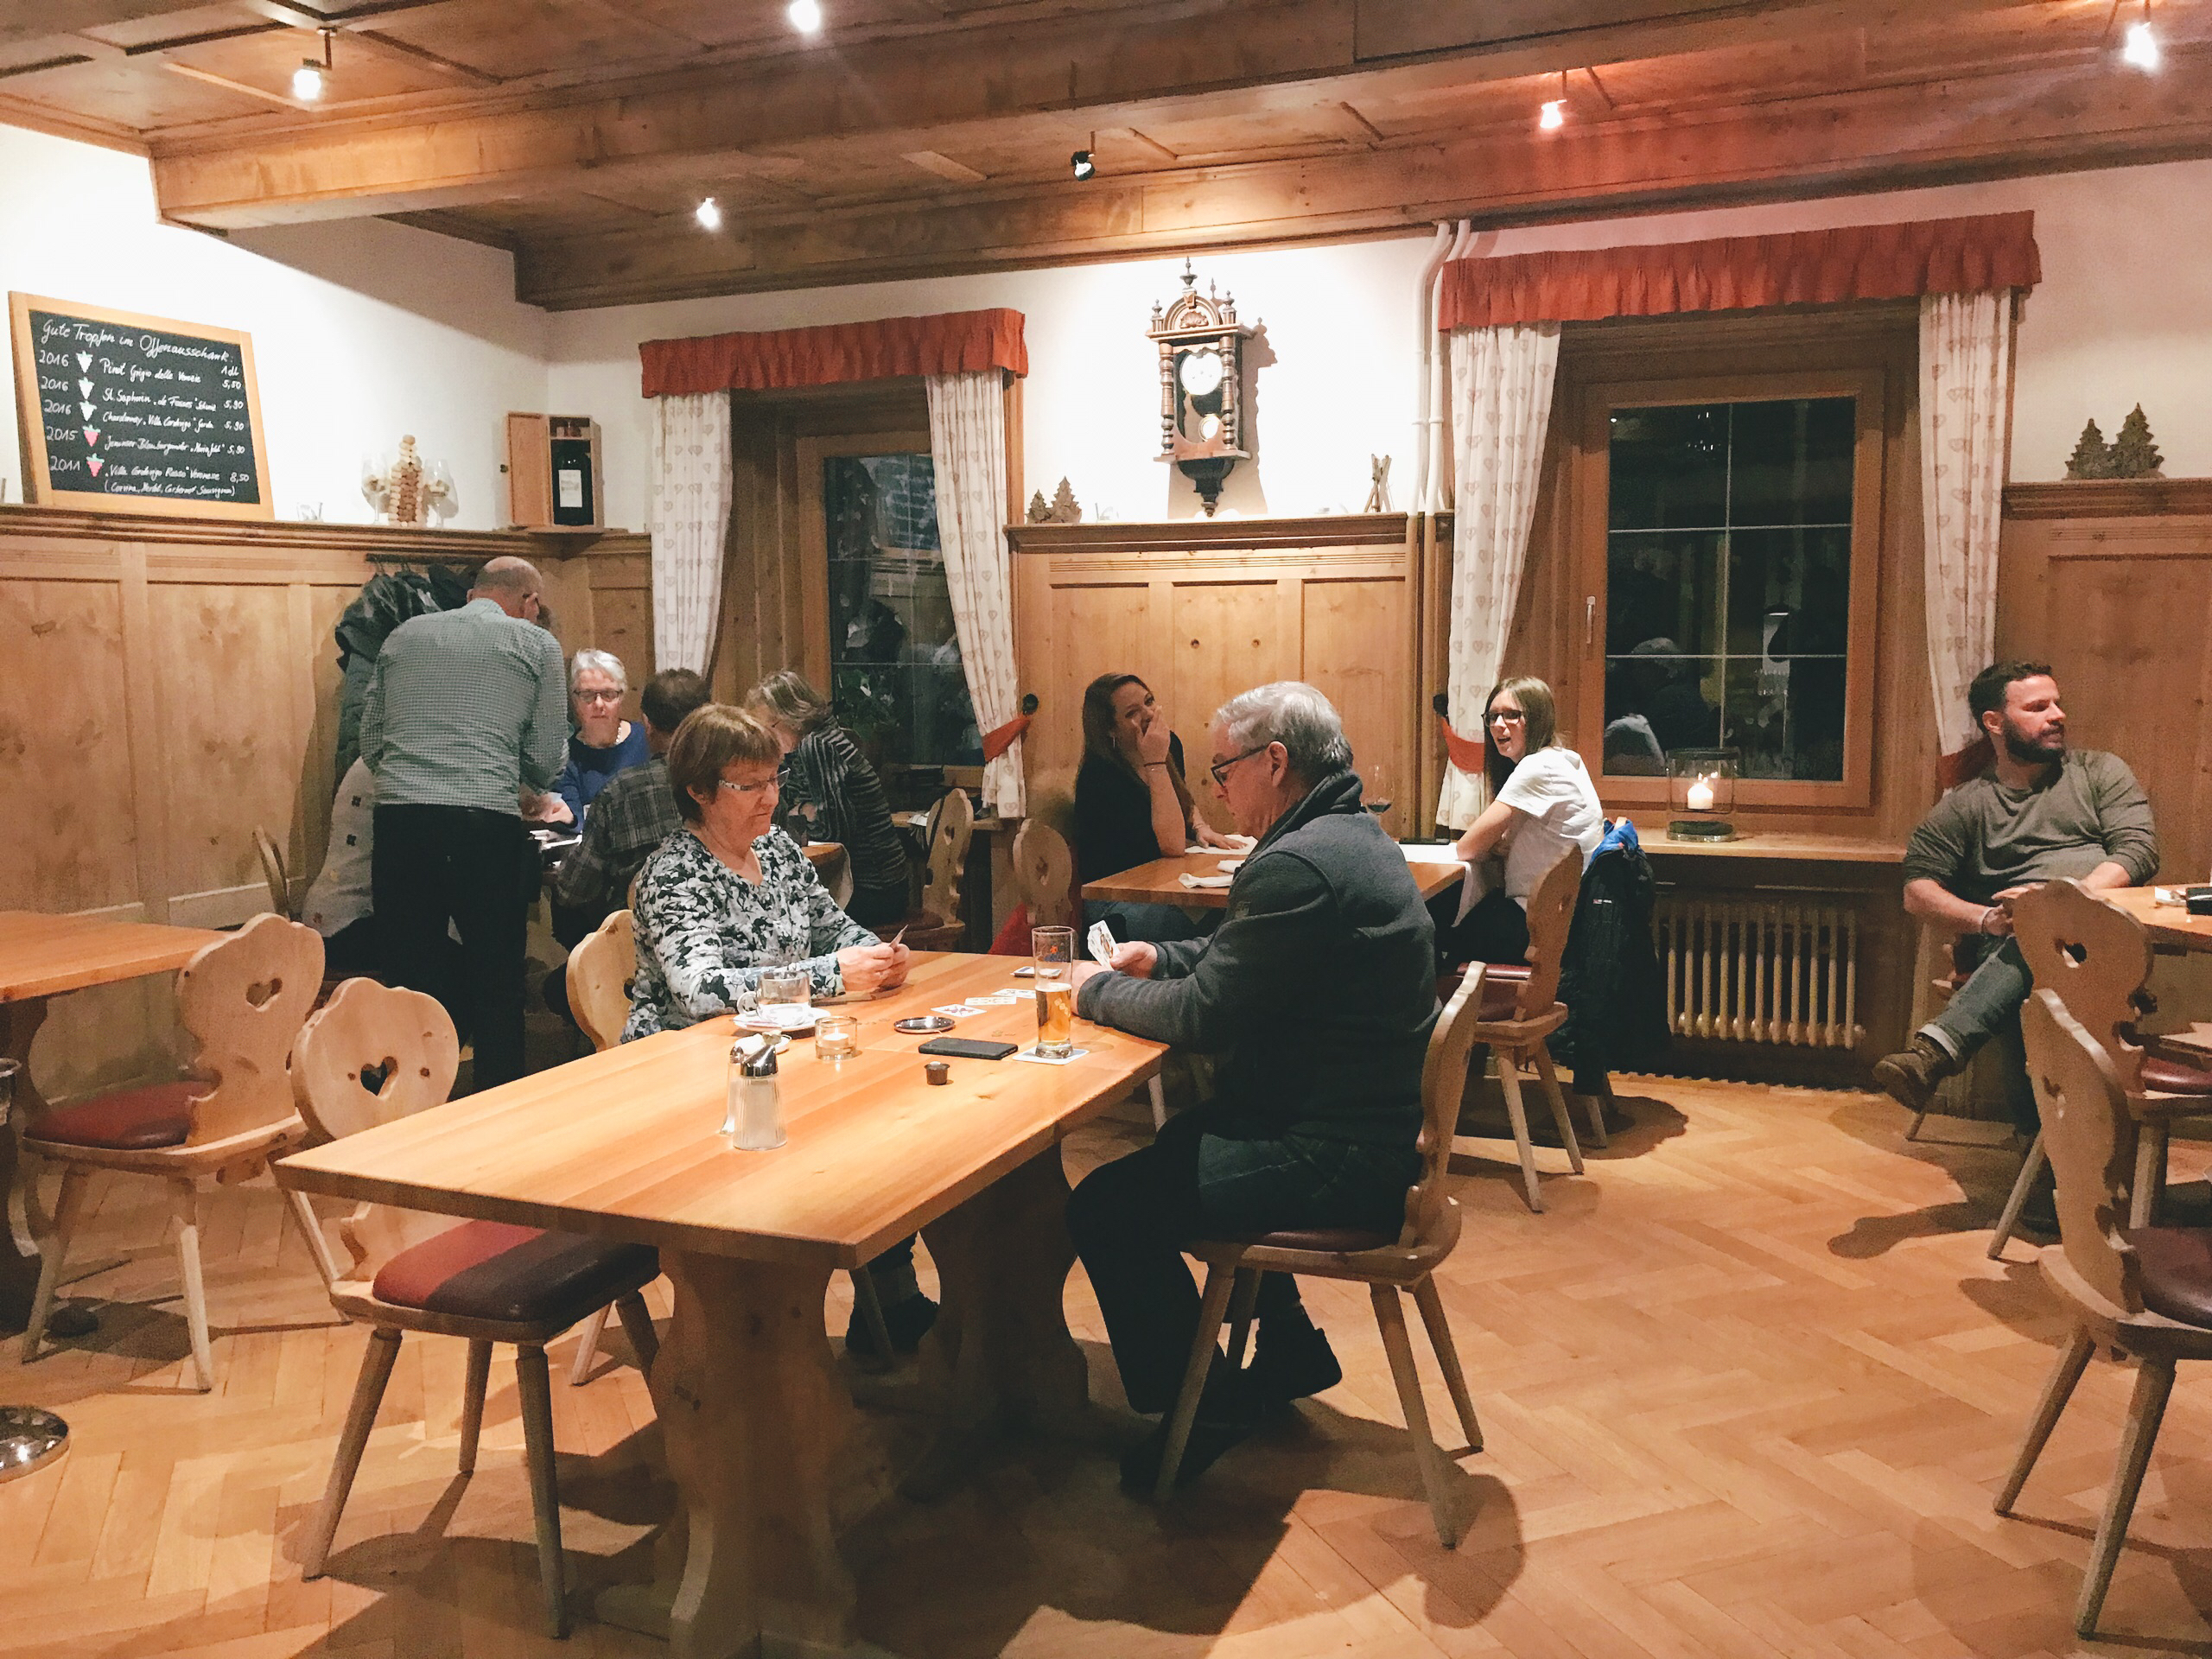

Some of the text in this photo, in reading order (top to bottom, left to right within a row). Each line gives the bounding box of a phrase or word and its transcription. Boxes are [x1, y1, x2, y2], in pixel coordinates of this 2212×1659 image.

[41, 319, 71, 345] Gute
[73, 323, 115, 348] Tropfen
[119, 332, 134, 347] im
[39, 349, 69, 367] 2016
[99, 357, 126, 376] Pinot
[130, 364, 152, 383] Grigio
[154, 368, 174, 380] delle
[222, 379, 242, 390] 5,50
[41, 375, 69, 391] 2016
[116, 389, 151, 406] Saphorin
[223, 399, 245, 410] 5,90
[44, 399, 72, 415] 2016
[224, 420, 245, 431] 5,90
[46, 425, 79, 441] 2015
[227, 444, 245, 455] 5,90
[49, 454, 81, 472] 2011
[229, 471, 250, 484] 8,50
